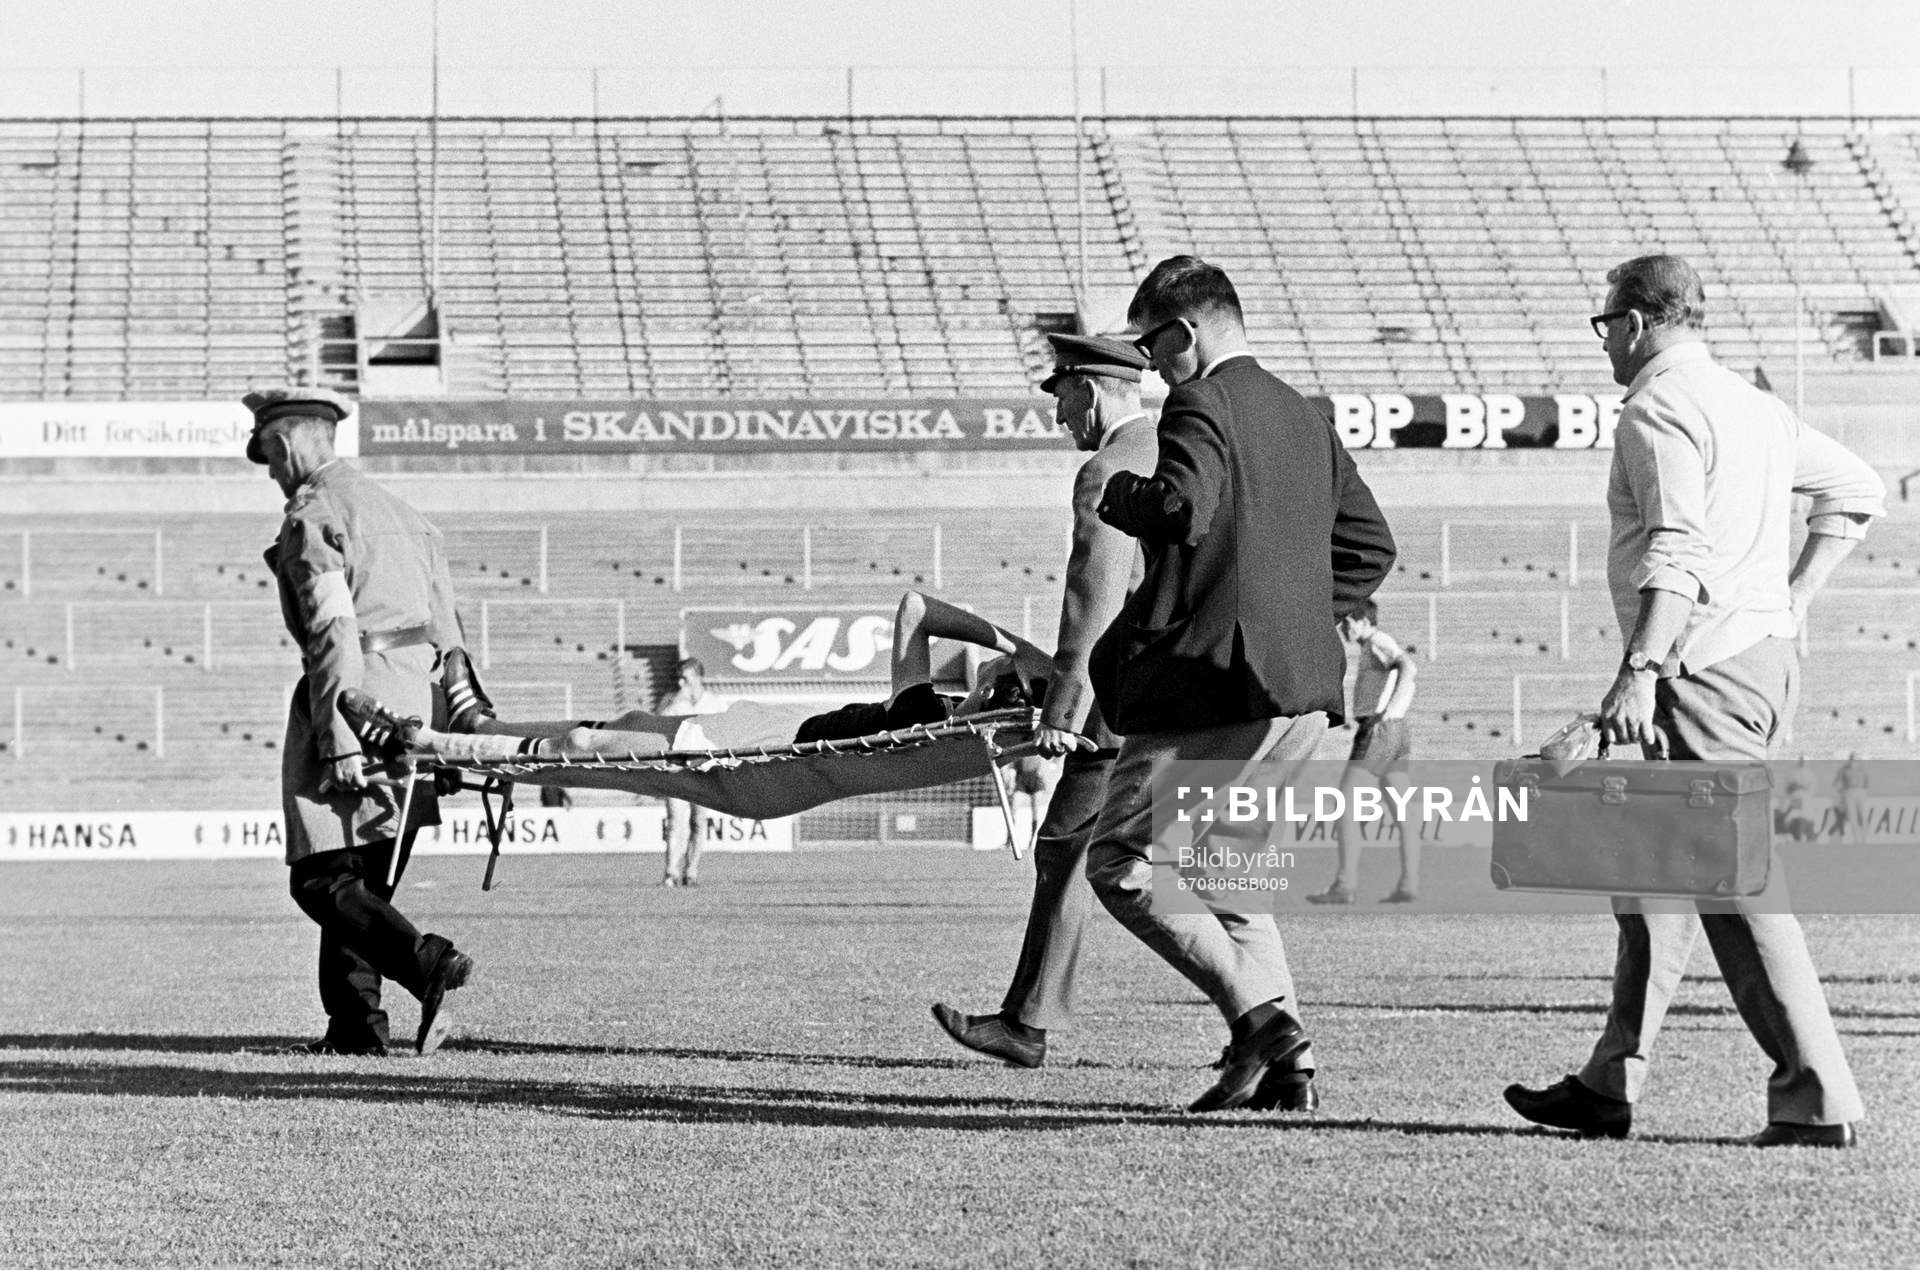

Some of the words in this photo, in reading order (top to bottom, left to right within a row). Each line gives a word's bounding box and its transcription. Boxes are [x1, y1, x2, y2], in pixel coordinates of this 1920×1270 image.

[42, 419, 87, 443] Ditt
[372, 417, 519, 449] målspara
[535, 417, 547, 442] i
[562, 408, 966, 442] SKANDINAVISKA
[1330, 393, 1414, 448] BP
[1442, 393, 1525, 448] BP
[731, 616, 892, 673] SAS
[28, 823, 137, 848] HANSA
[452, 819, 559, 843] HANSA
